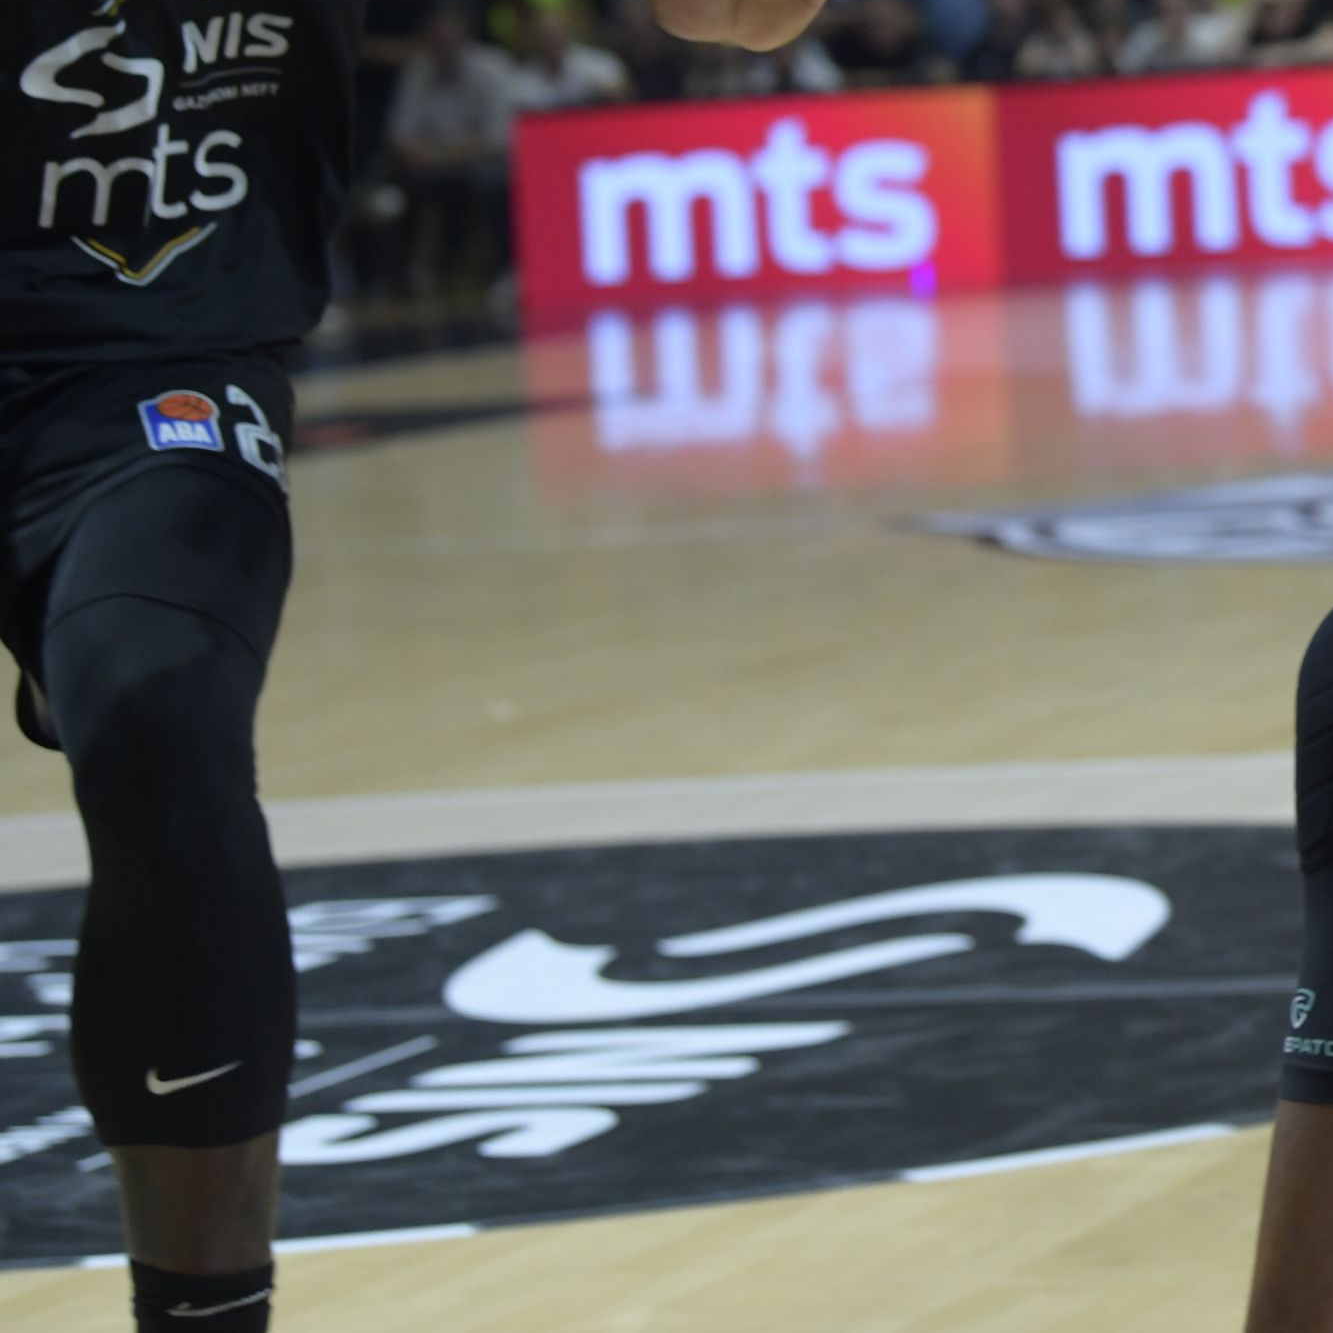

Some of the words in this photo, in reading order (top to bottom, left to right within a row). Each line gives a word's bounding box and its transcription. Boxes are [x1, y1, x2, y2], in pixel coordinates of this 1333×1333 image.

[181, 10, 295, 75] NIS
[38, 120, 251, 230] mts
[579, 116, 940, 288] mts
